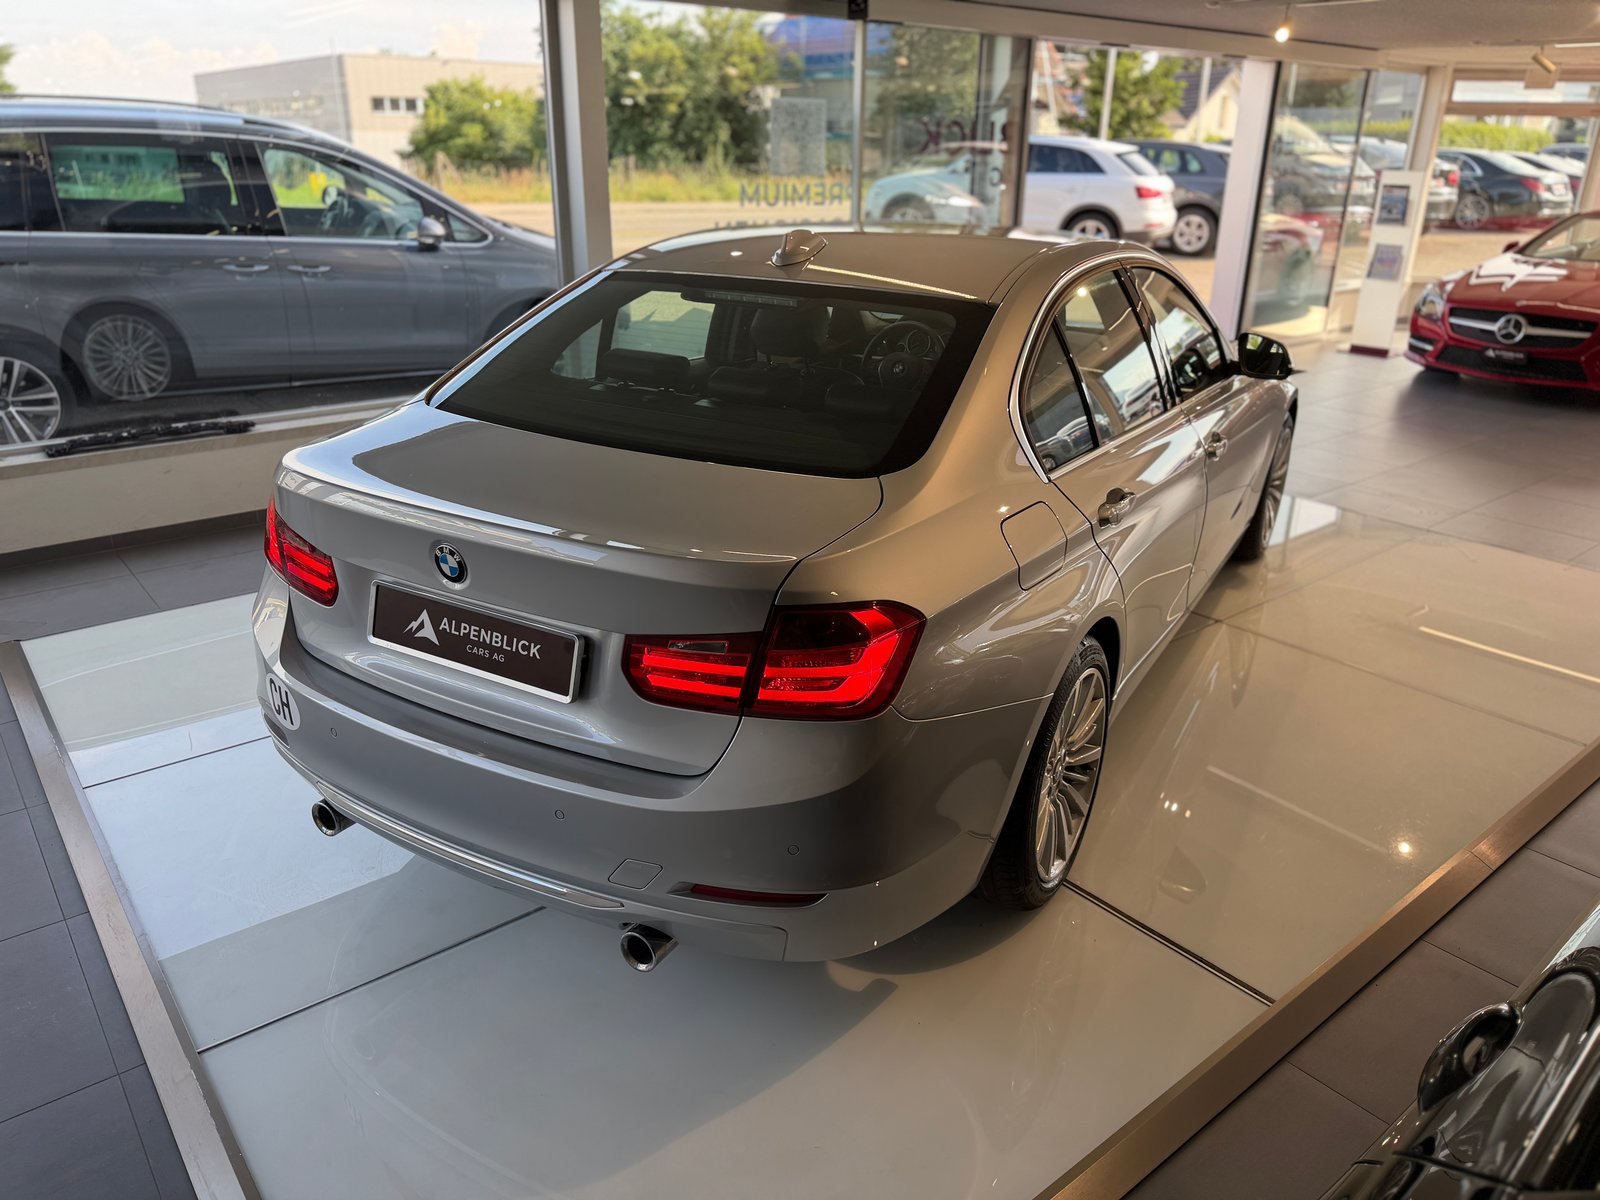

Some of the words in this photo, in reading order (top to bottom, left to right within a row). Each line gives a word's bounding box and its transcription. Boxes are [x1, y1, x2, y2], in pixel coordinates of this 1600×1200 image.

[435, 546, 461, 562] BMW
[439, 617, 541, 660] ALPENBLICK
[466, 644, 490, 658] CARS
[492, 653, 505, 663] AG
[269, 677, 294, 726] CH
